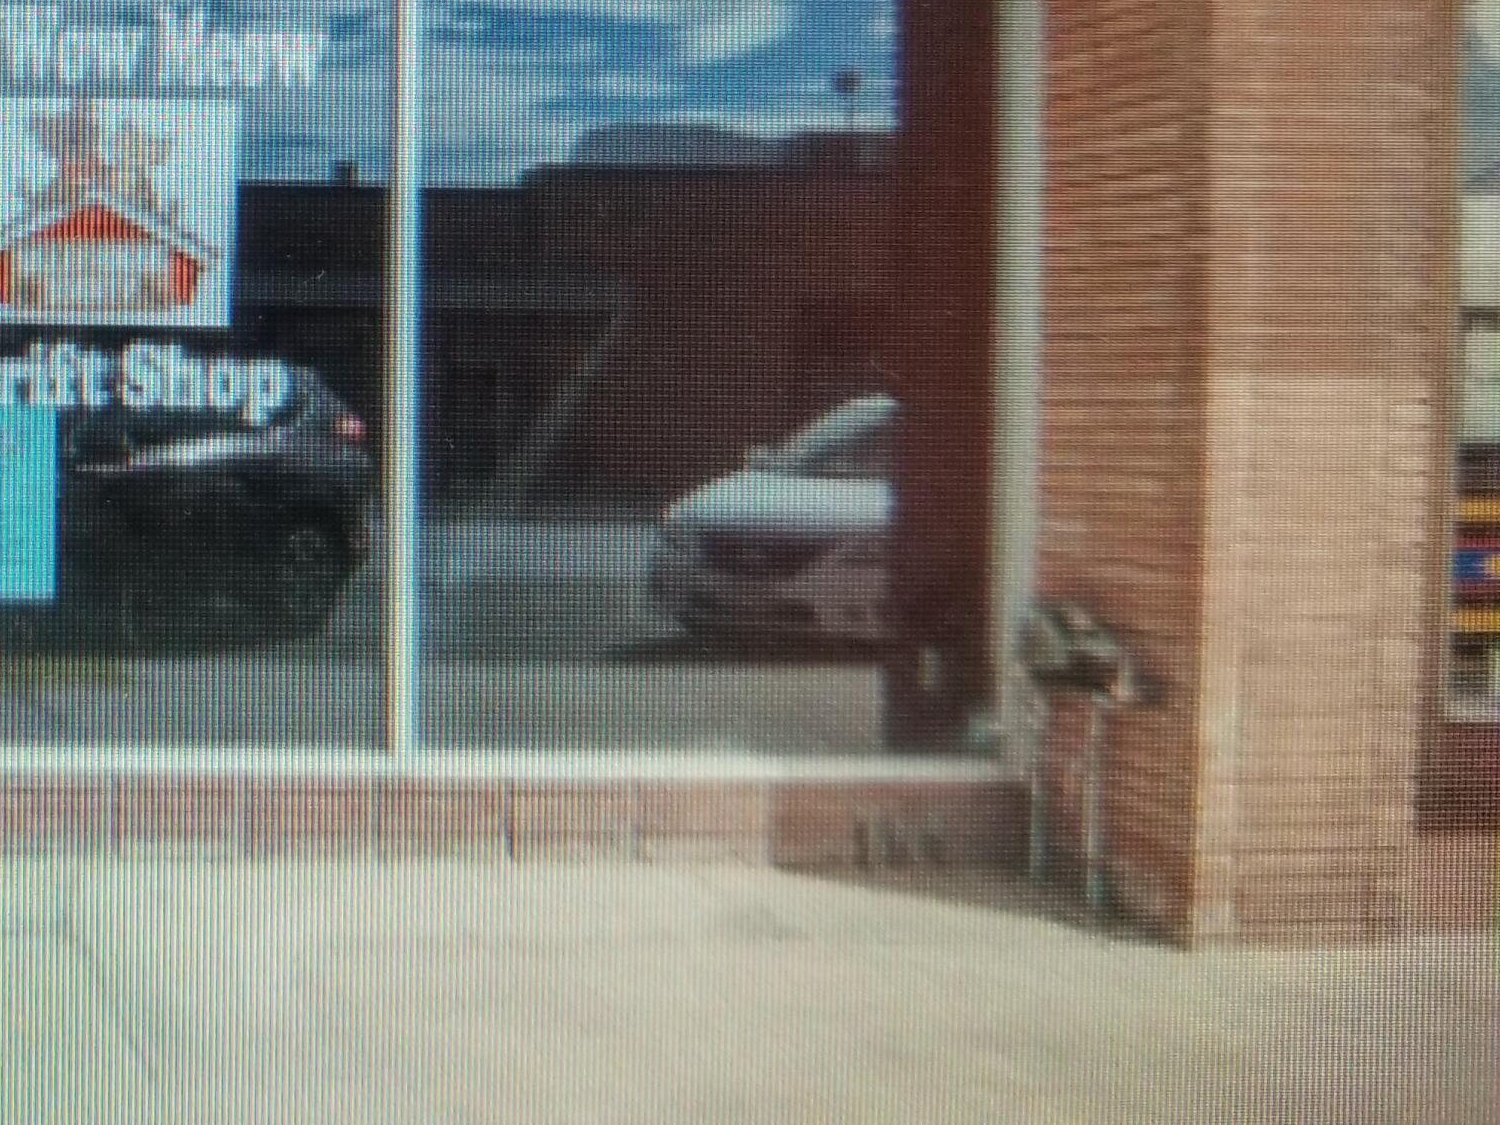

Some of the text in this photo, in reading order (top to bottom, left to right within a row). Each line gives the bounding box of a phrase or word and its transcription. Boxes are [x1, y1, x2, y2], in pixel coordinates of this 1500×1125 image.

[0, 4, 145, 85] Wow
[156, 5, 327, 87] Meow
[121, 338, 291, 427] Shop
